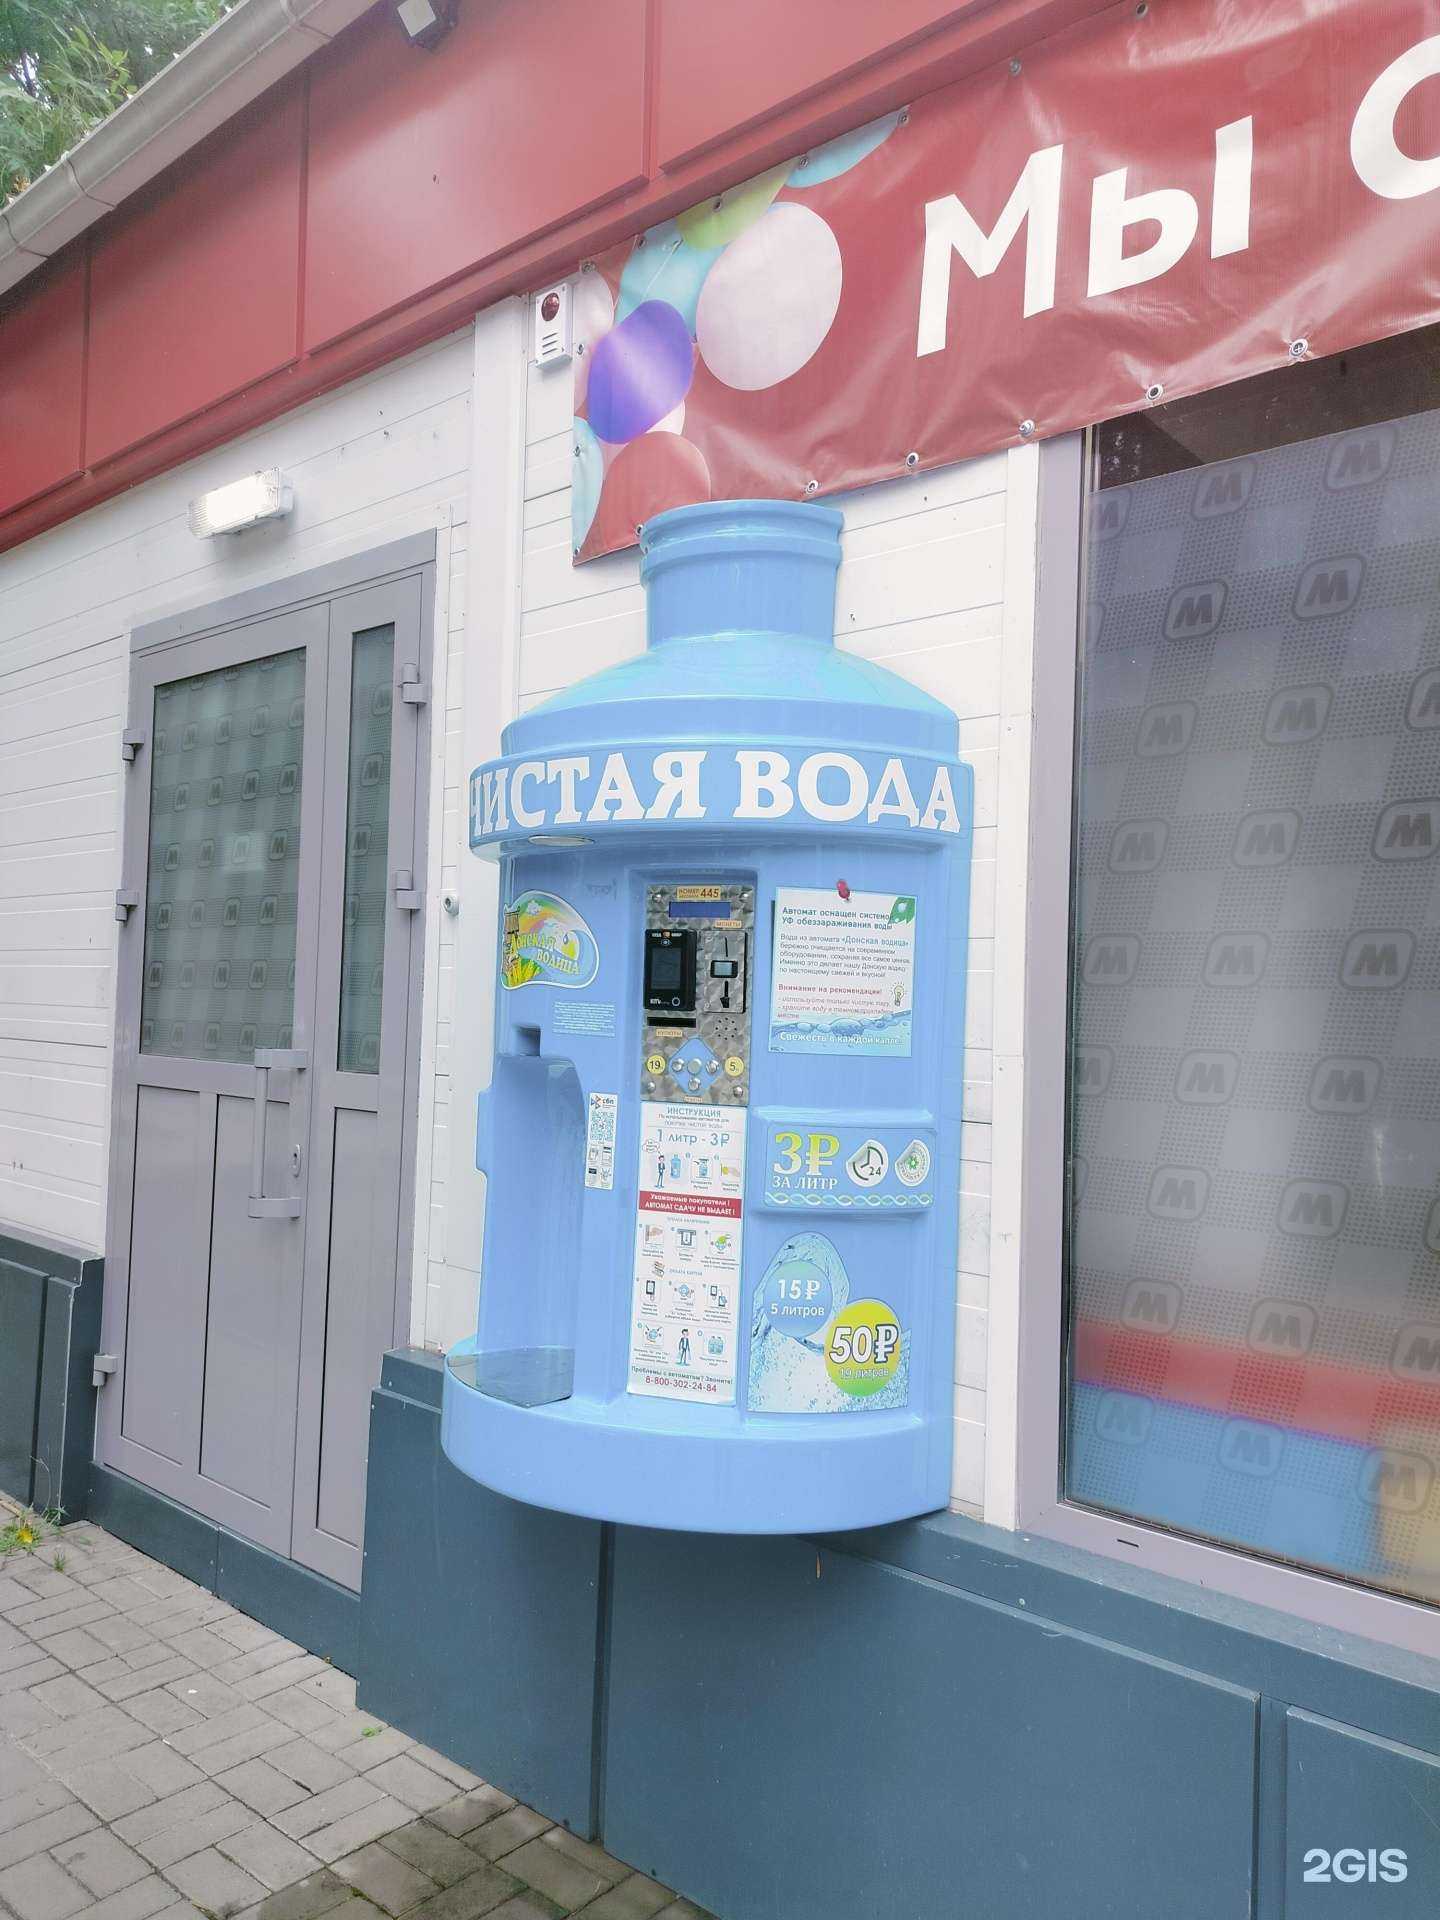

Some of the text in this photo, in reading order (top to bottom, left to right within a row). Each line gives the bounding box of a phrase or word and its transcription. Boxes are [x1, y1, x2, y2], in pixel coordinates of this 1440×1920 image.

[471, 750, 960, 836] ЧИСТАЯ ВОДА
[701, 888, 719, 898] 445
[782, 907, 817, 916] Автомат
[820, 910, 857, 919] оснащен
[782, 917, 794, 925] УФ
[797, 918, 872, 929] обеззараживания
[667, 1107, 720, 1117] ИНСТРУКЦИЯ
[658, 1129, 663, 1141] 1
[668, 1134, 697, 1145] литр
[869, 1166, 882, 1177] 24
[772, 1177, 838, 1190] ЗА ЛИТР
[645, 1202, 673, 1210] АВТОМАТ
[674, 1204, 696, 1212] СДАЧУ
[771, 1304, 825, 1318] 5 литров
[645, 1375, 717, 1392] 8-800-302-24-84
